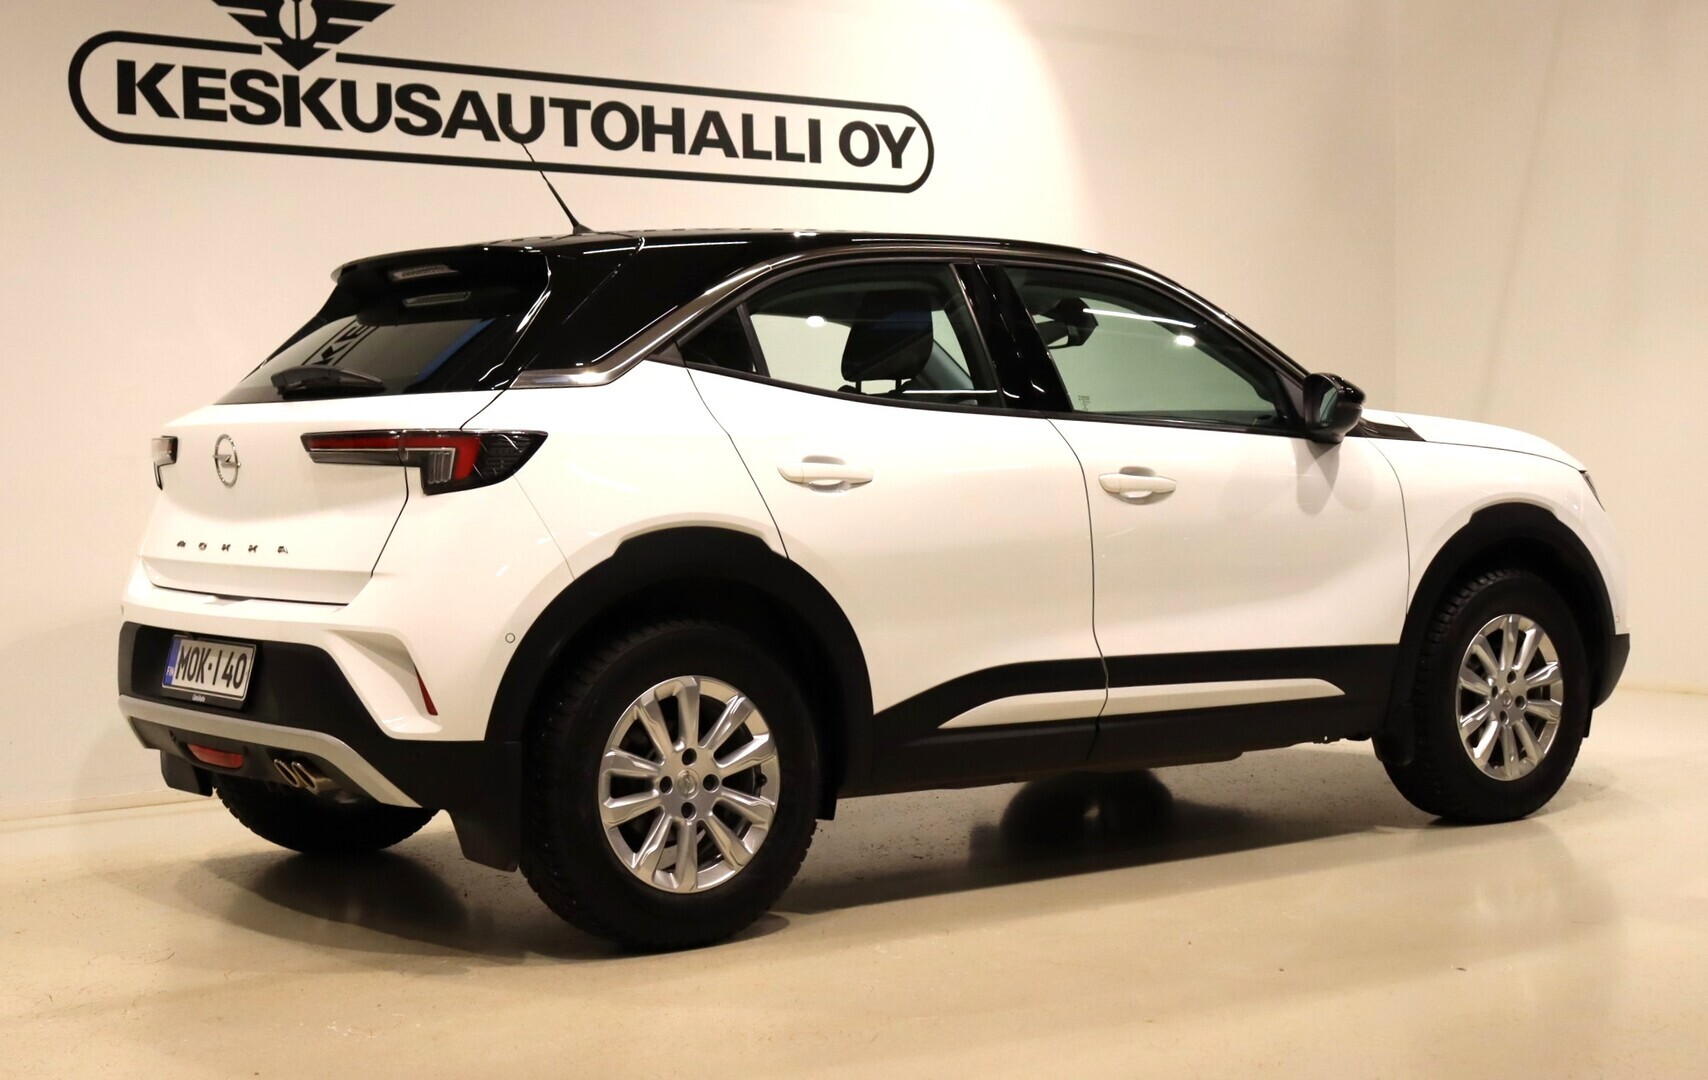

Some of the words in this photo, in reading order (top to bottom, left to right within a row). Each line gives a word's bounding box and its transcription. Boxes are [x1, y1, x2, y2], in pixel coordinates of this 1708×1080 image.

[116, 60, 822, 164] KESKUSAUTOHALLI
[838, 121, 916, 169] OY
[175, 645, 248, 689] MOK-140
